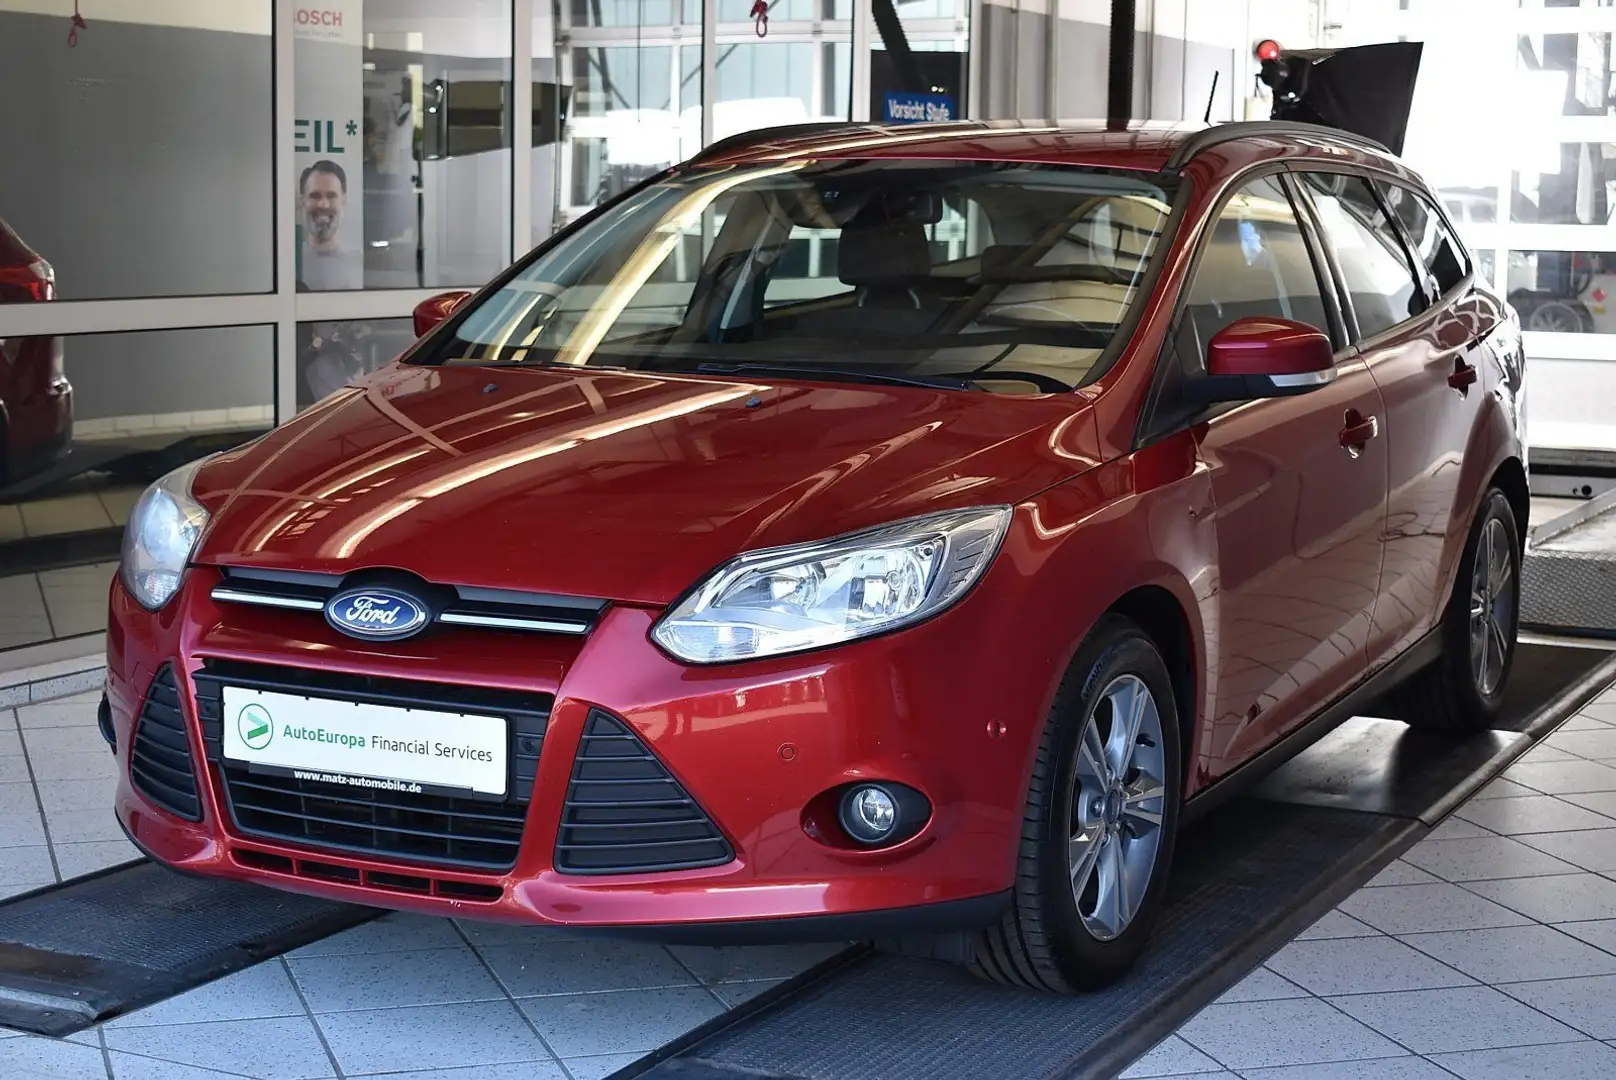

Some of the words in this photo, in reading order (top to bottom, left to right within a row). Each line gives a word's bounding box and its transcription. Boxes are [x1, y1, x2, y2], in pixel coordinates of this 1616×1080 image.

[294, 10, 342, 26] OSCH
[888, 99, 925, 120] Vorsicht
[346, 596, 401, 625] Ford
[283, 724, 366, 748] AutoEuropa
[371, 735, 430, 755] Financial
[435, 742, 493, 762] Services
[293, 770, 422, 793] www.matz-automobile.de
